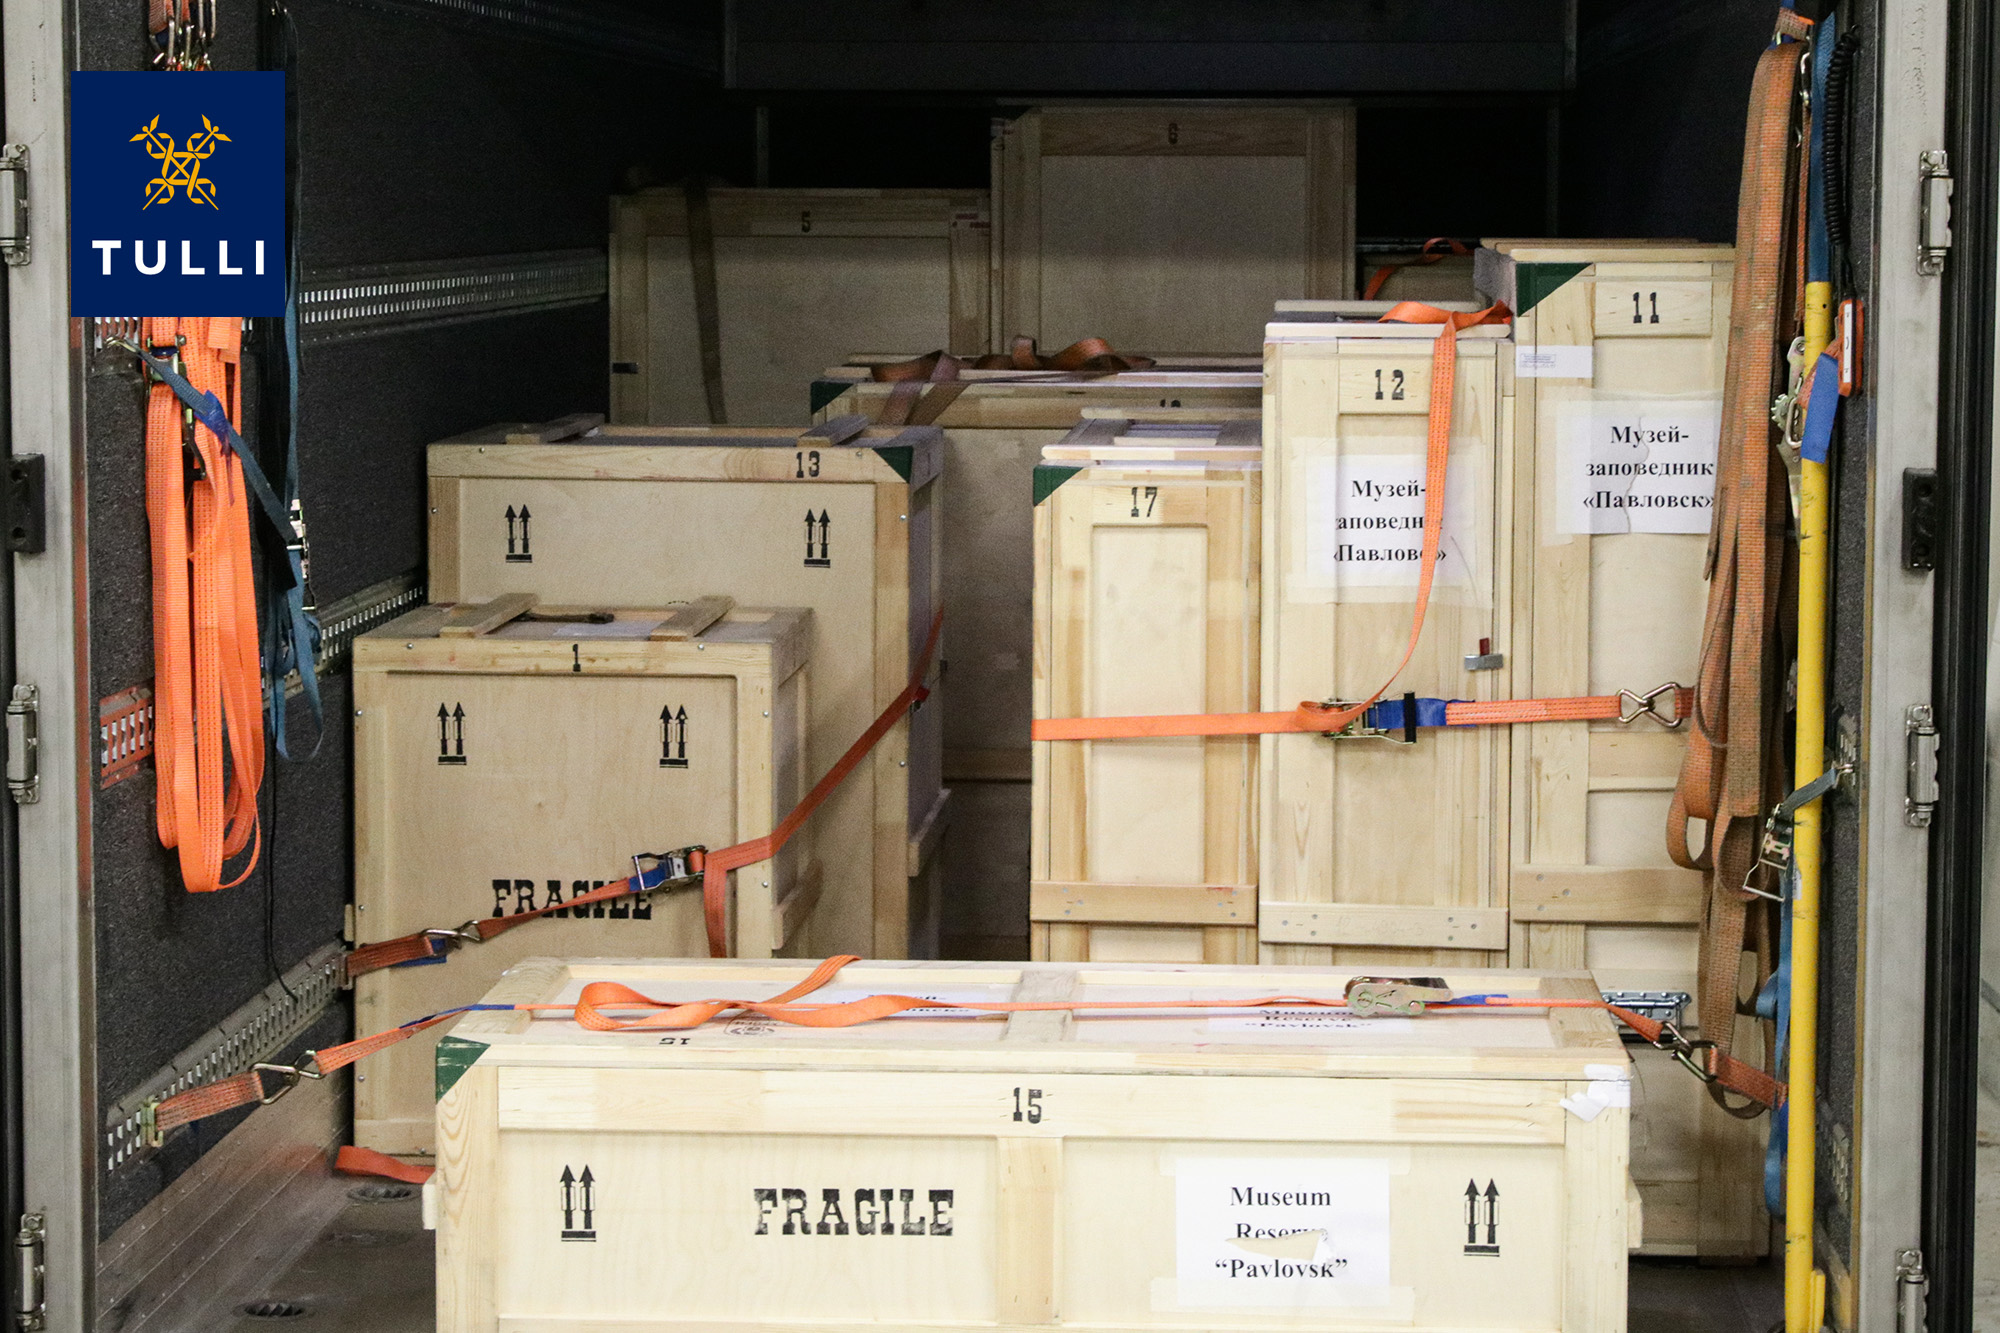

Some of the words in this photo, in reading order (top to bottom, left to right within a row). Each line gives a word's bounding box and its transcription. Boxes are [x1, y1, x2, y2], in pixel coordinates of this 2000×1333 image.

[801, 210, 811, 233] 5
[1632, 292, 1660, 324] 11
[1374, 369, 1405, 401] 12
[1610, 425, 1689, 448] Музей-
[796, 450, 820, 478] 13
[1585, 462, 1714, 477] заповедник
[1131, 486, 1158, 517] 17
[572, 643, 581, 673] 1
[1013, 1087, 1042, 1124] 15
[1230, 1186, 1331, 1206] Museum
[754, 1188, 954, 1237] FRAGILE
